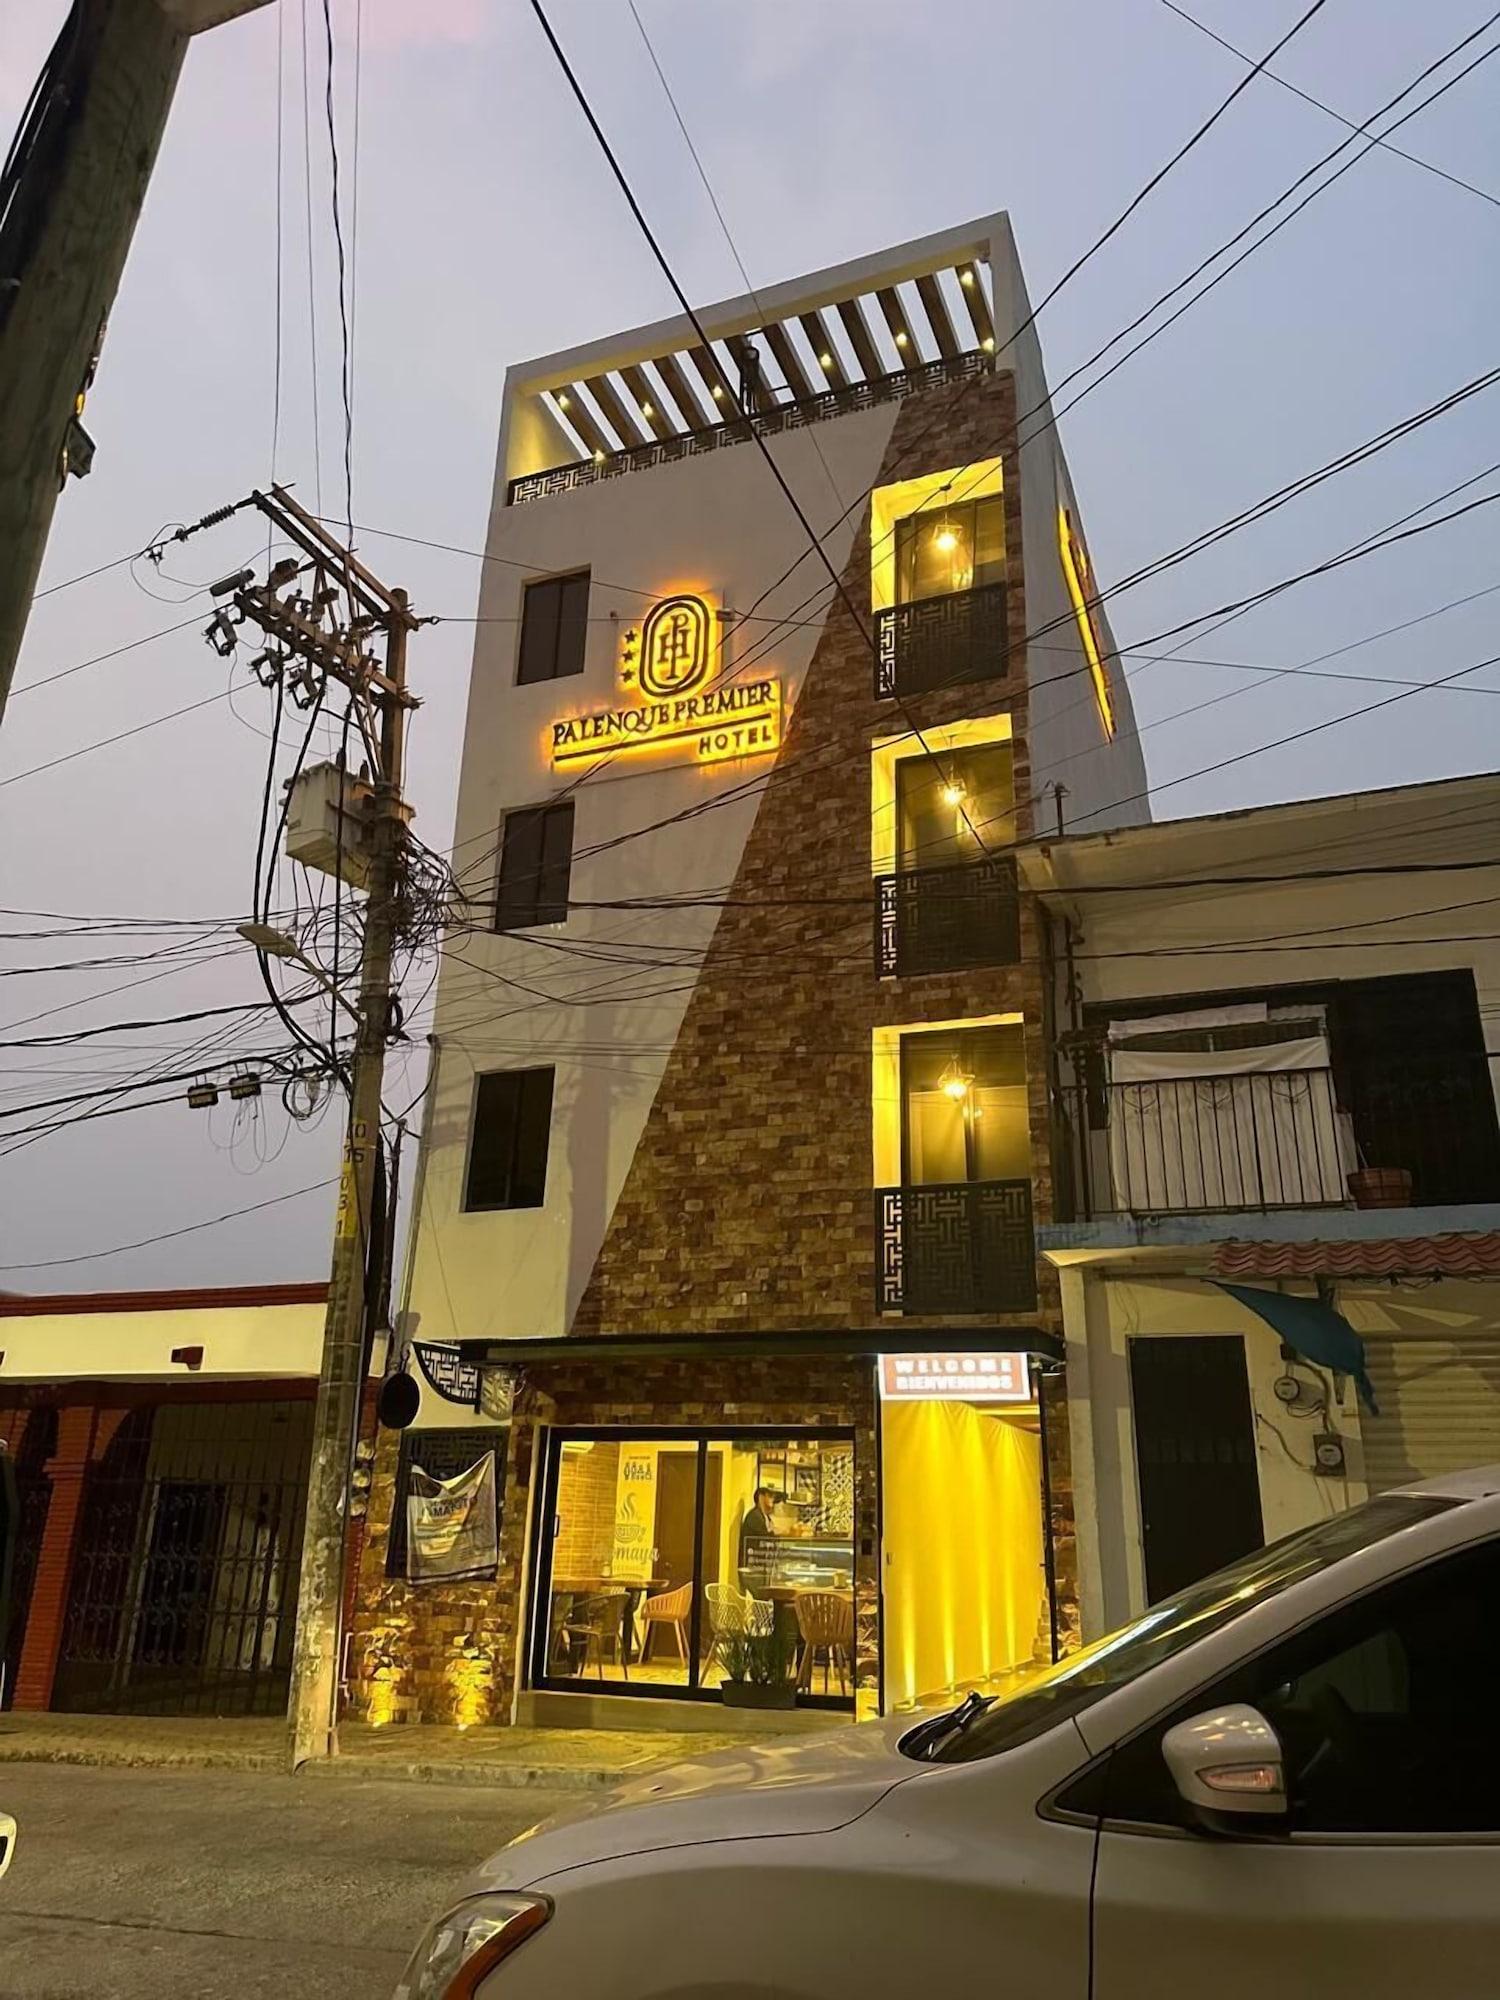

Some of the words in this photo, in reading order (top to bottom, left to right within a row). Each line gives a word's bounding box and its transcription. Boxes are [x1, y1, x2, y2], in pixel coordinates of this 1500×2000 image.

[553, 710, 670, 746] PALENQUE
[673, 681, 775, 722] PREMIER
[699, 725, 772, 754] HOTEL
